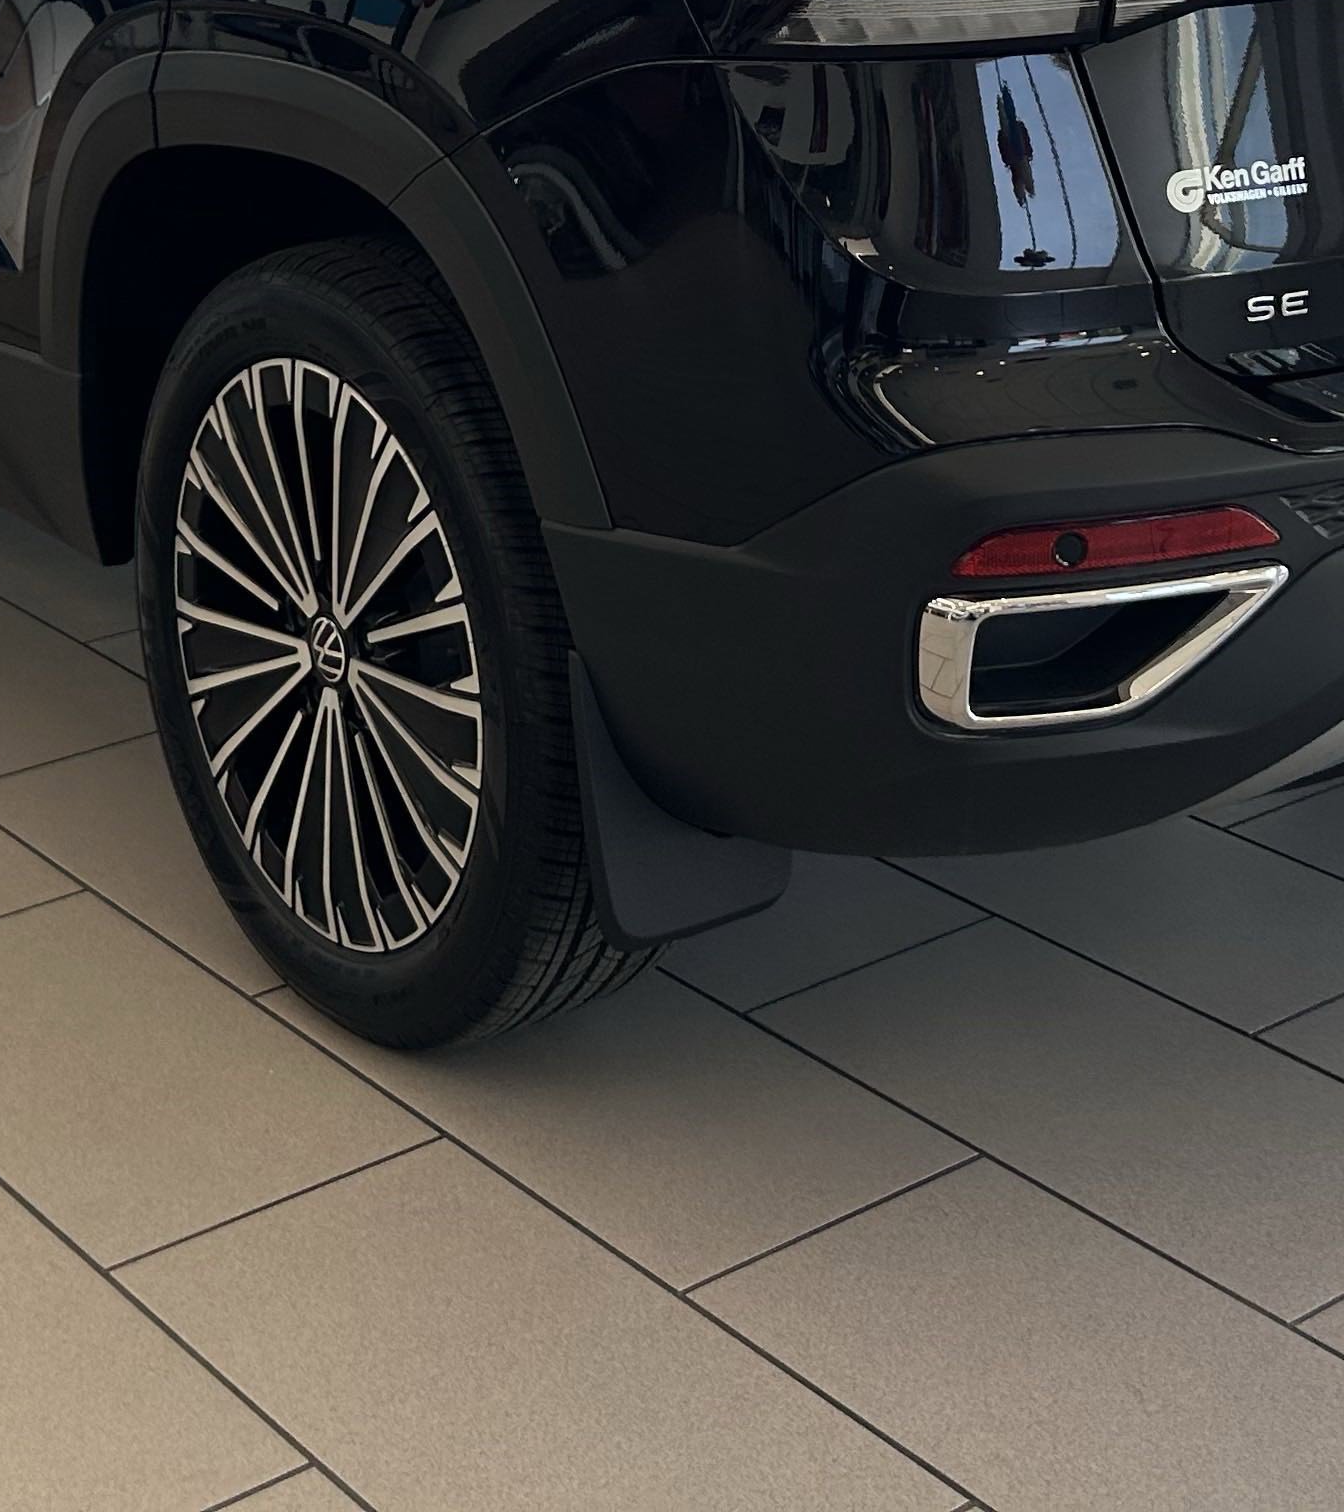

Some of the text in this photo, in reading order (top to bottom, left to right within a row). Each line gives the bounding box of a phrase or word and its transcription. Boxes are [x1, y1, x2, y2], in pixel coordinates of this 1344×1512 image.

[1204, 165, 1250, 191] Ken
[1251, 156, 1306, 185] Garff
[1207, 188, 1267, 205] VOLKSWAGEN
[1246, 290, 1309, 322] SE
